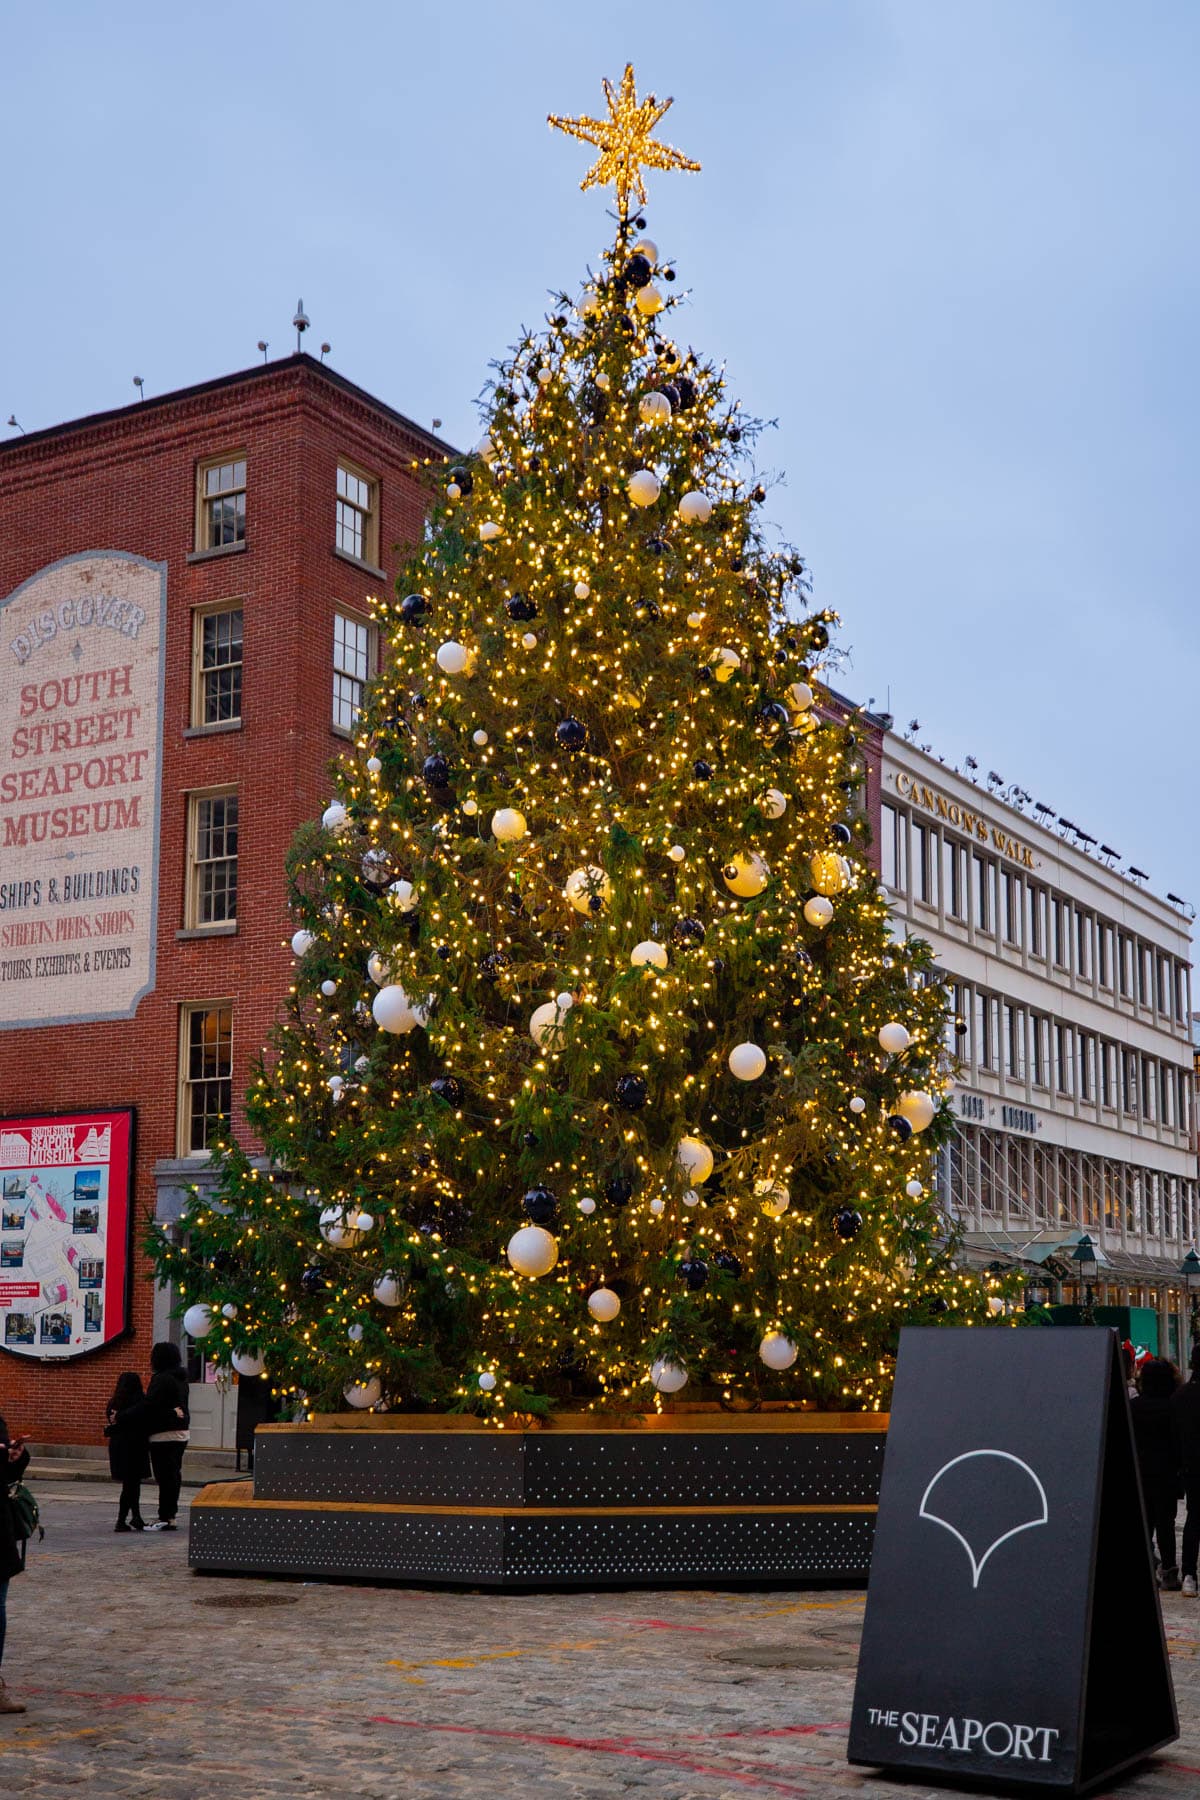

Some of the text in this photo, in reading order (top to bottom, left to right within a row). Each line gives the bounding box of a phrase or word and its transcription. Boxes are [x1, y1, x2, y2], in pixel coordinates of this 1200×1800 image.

[10, 595, 145, 665] DISCOVER
[20, 665, 133, 718] SOUTH
[12, 708, 141, 759] STREET
[0, 750, 148, 803] SEAPORT
[3, 796, 141, 847] MUSEUM
[895, 772, 1035, 870] CANNON'S WALK
[0, 866, 140, 910] SHIPS & BUILDINGS
[94, 909, 135, 938] SHOPS
[83, 952, 91, 973] &
[94, 947, 131, 972] EVENTS
[31, 1125, 76, 1137] SOUTH STREET
[31, 1135, 75, 1152] SEAPORT
[31, 1147, 75, 1165] MUSEUM
[868, 1708, 1059, 1761] THE SEAPORT
